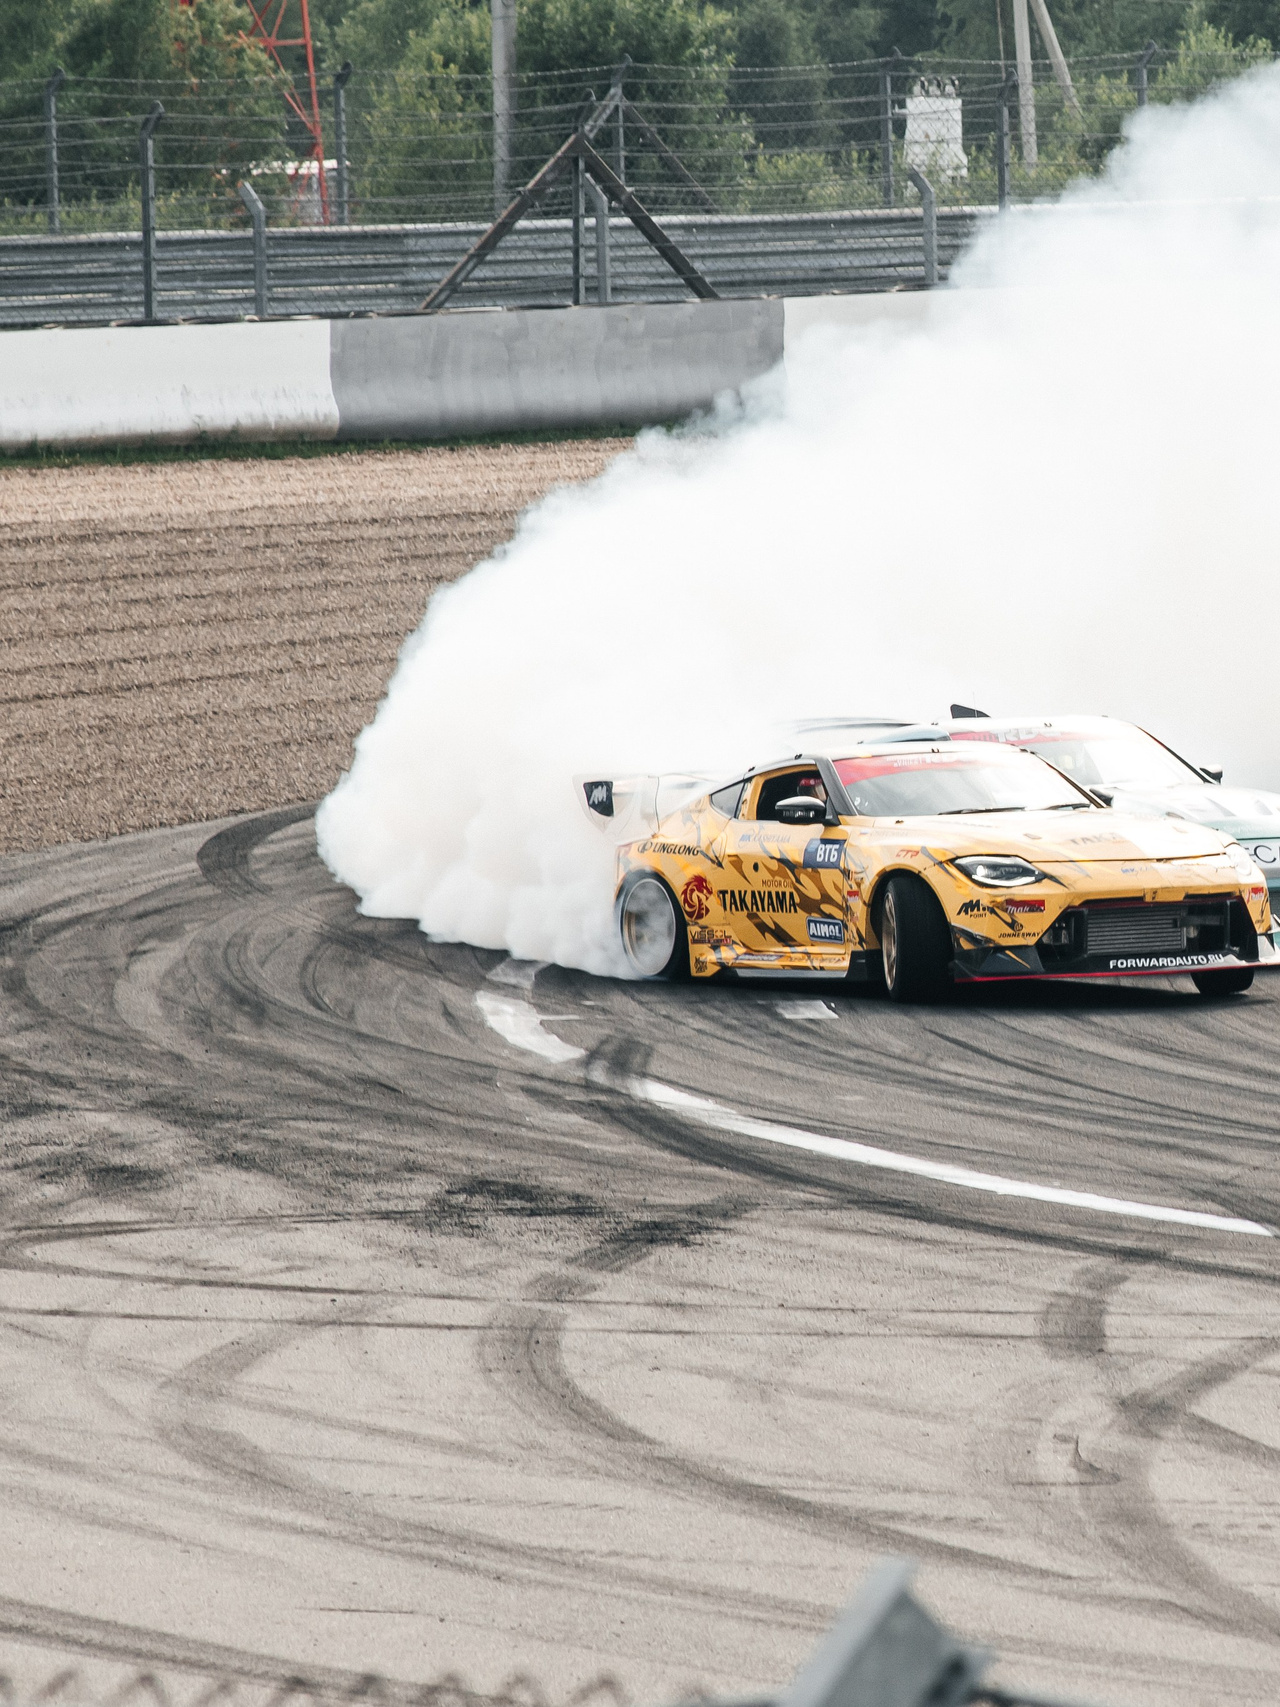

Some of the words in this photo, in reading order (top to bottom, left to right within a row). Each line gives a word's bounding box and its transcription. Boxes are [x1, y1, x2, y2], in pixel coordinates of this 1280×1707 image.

[652, 842, 701, 857] LINGLONG
[816, 843, 840, 863] ВТБ
[761, 879, 783, 889] MOTOR
[718, 889, 798, 914] TAKAYAMA
[808, 921, 842, 938] AIMOL
[998, 931, 1041, 939] JONNESWAY
[1109, 953, 1225, 970] FORWARDAUTO.RU
